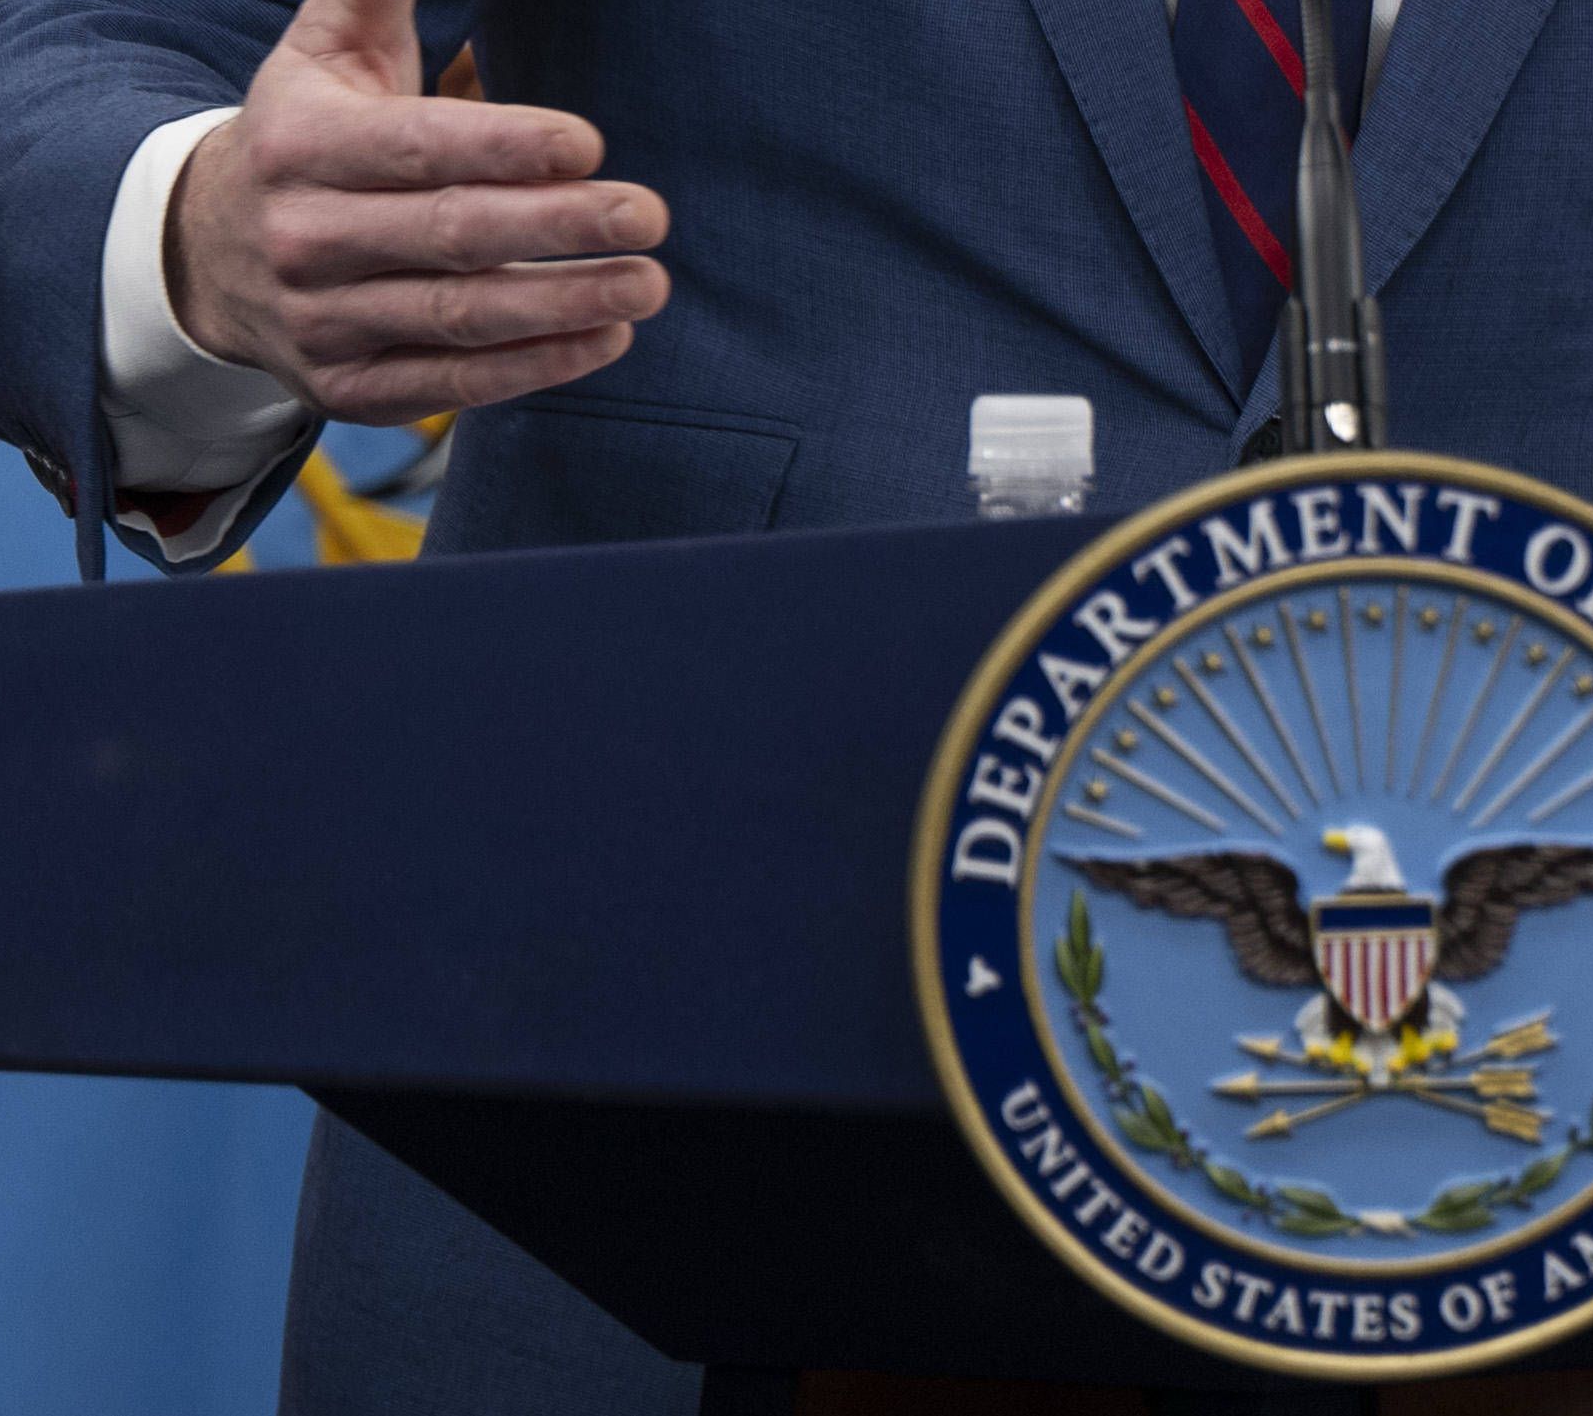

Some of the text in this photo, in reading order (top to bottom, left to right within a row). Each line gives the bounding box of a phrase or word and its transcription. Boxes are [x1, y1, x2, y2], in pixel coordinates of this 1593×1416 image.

[953, 484, 1498, 888] DEPARTMENT
[1000, 1083, 1186, 1282] UNITED
[1192, 1264, 1419, 1342] STATES
[1439, 1273, 1519, 1332] OF
